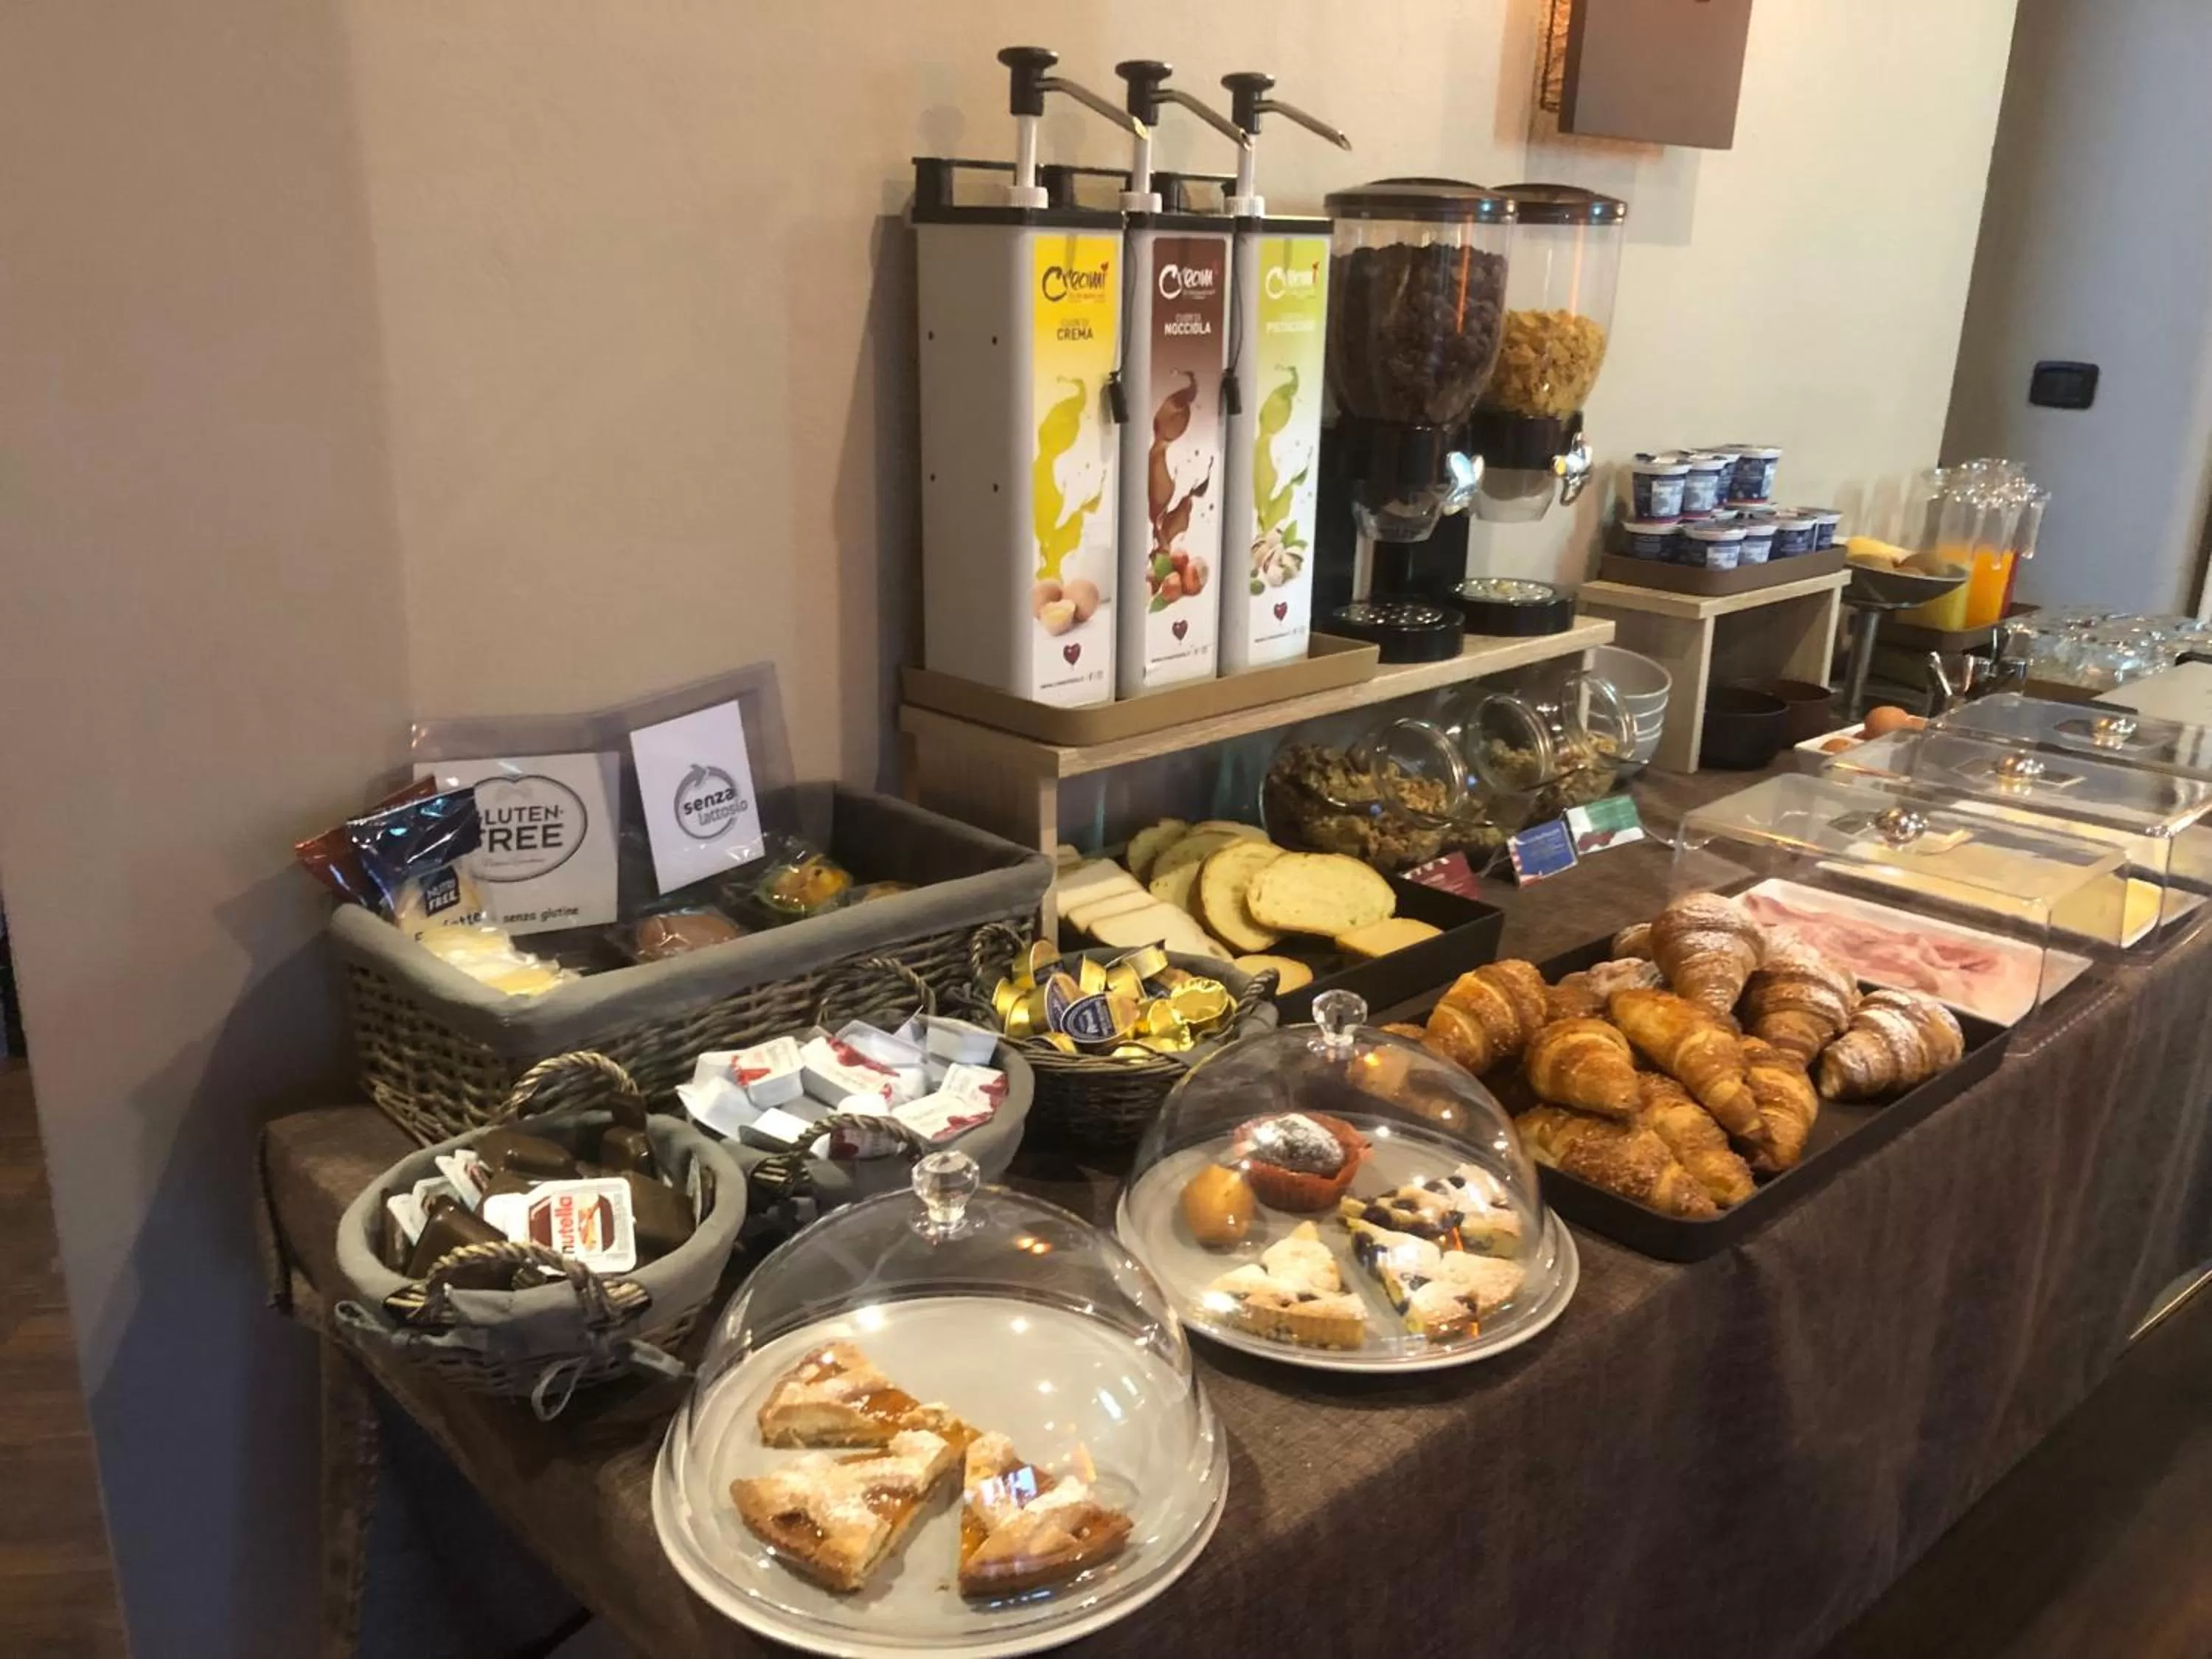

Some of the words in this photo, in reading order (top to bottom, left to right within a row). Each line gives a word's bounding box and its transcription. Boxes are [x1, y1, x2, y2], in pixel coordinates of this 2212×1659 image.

[1057, 327, 1093, 341] CREMA
[1164, 321, 1211, 335] NOCCIOLA
[684, 788, 736, 815] senza
[503, 911, 537, 923] senza
[540, 906, 580, 922] glutine
[554, 1196, 575, 1254] nutella
